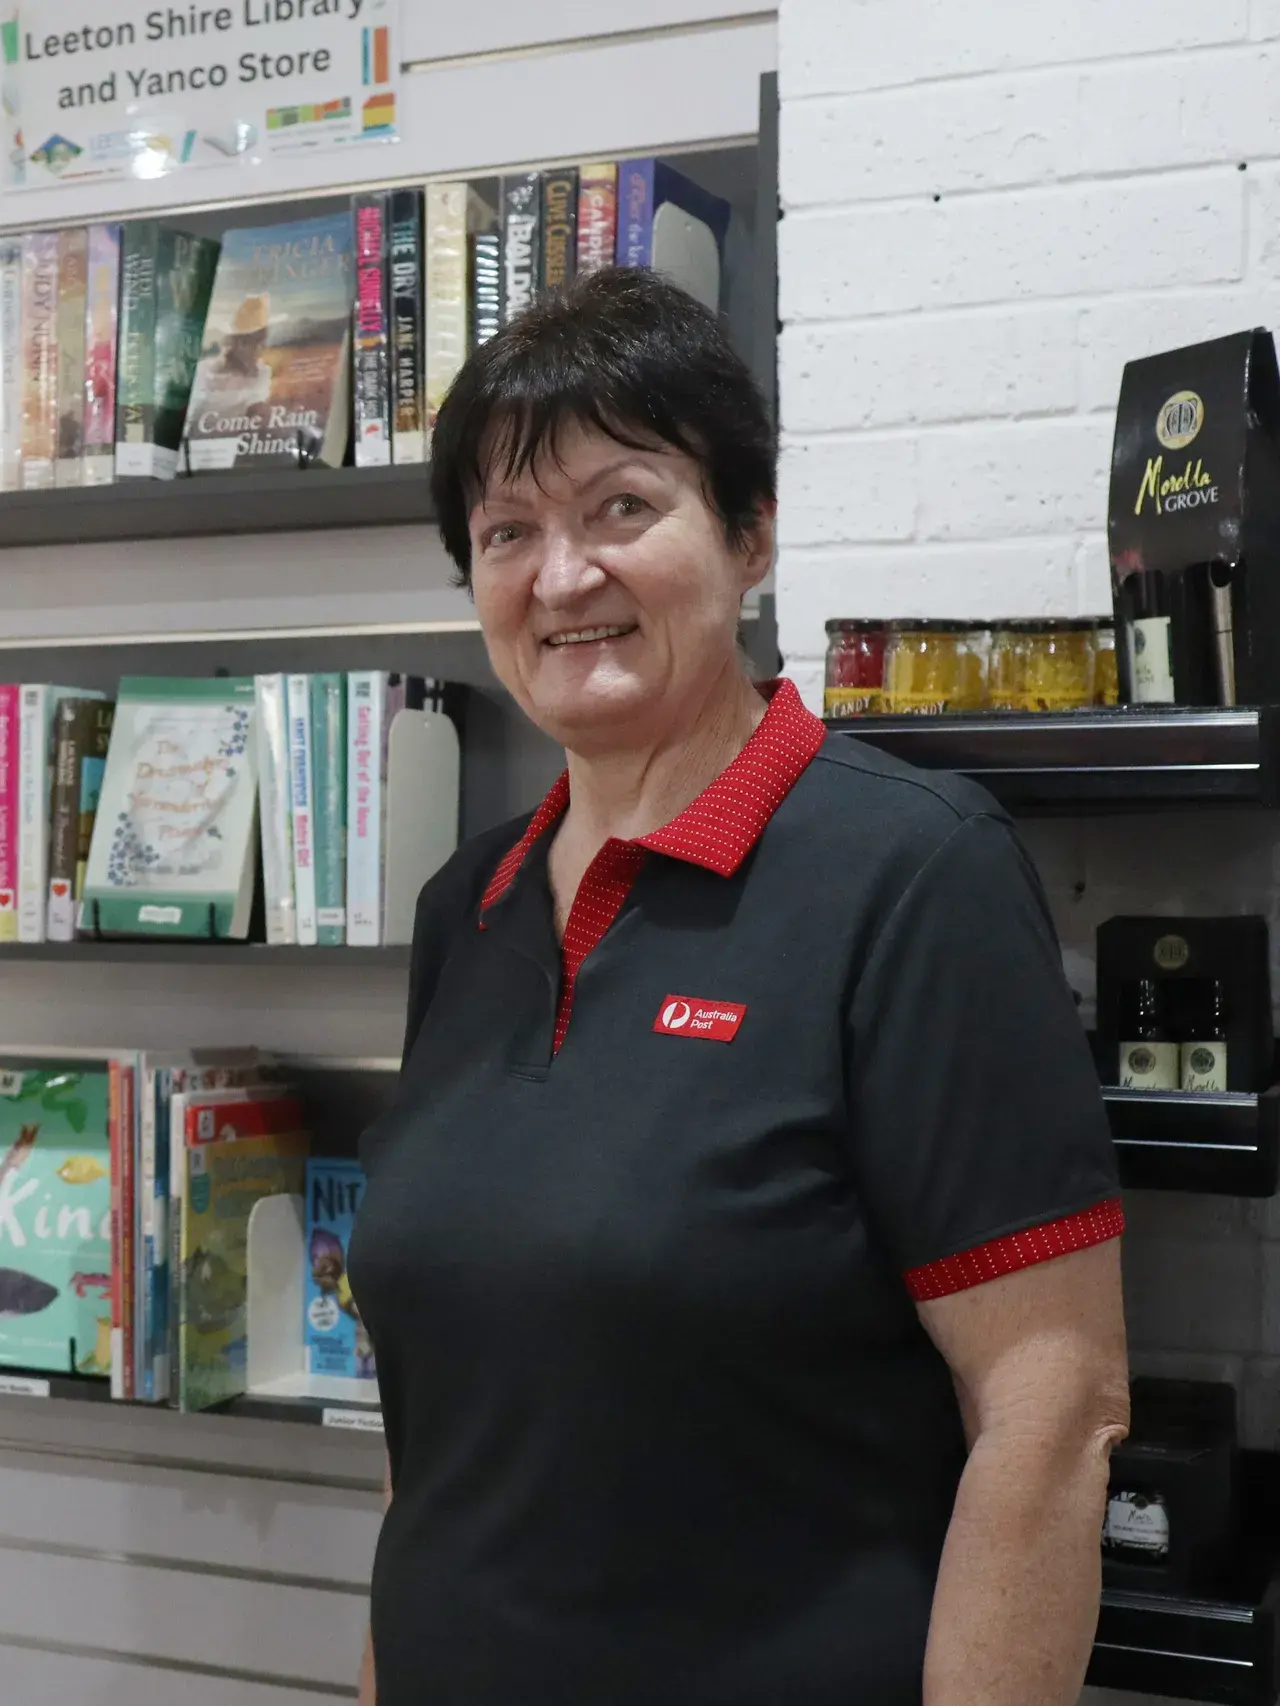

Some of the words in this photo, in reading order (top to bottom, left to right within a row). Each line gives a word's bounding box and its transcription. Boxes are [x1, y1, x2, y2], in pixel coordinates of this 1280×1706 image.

[25, 19, 135, 61] Leeton
[145, 3, 232, 41] Shire
[243, 0, 365, 28] Library
[58, 74, 116, 109] and
[127, 61, 227, 98] Yanco
[238, 47, 332, 83] Store
[545, 181, 572, 222] CLIVE
[358, 207, 382, 266] MICHAEL
[392, 218, 416, 256] THE
[393, 261, 416, 300] DRY
[358, 268, 382, 331] CONNELLY
[396, 316, 415, 351] JANE
[397, 357, 415, 417] HARPER
[198, 411, 262, 434] Come
[269, 404, 318, 430] Rain
[236, 431, 297, 456] Shine
[1134, 454, 1213, 516] Morella
[1164, 485, 1220, 513] GROVE
[353, 705, 372, 747] Getting
[355, 749, 371, 768] Out
[356, 770, 371, 783] of
[356, 786, 371, 803] the
[355, 806, 371, 839] House
[690, 1019, 713, 1030] Post
[694, 1008, 738, 1023] Australia
